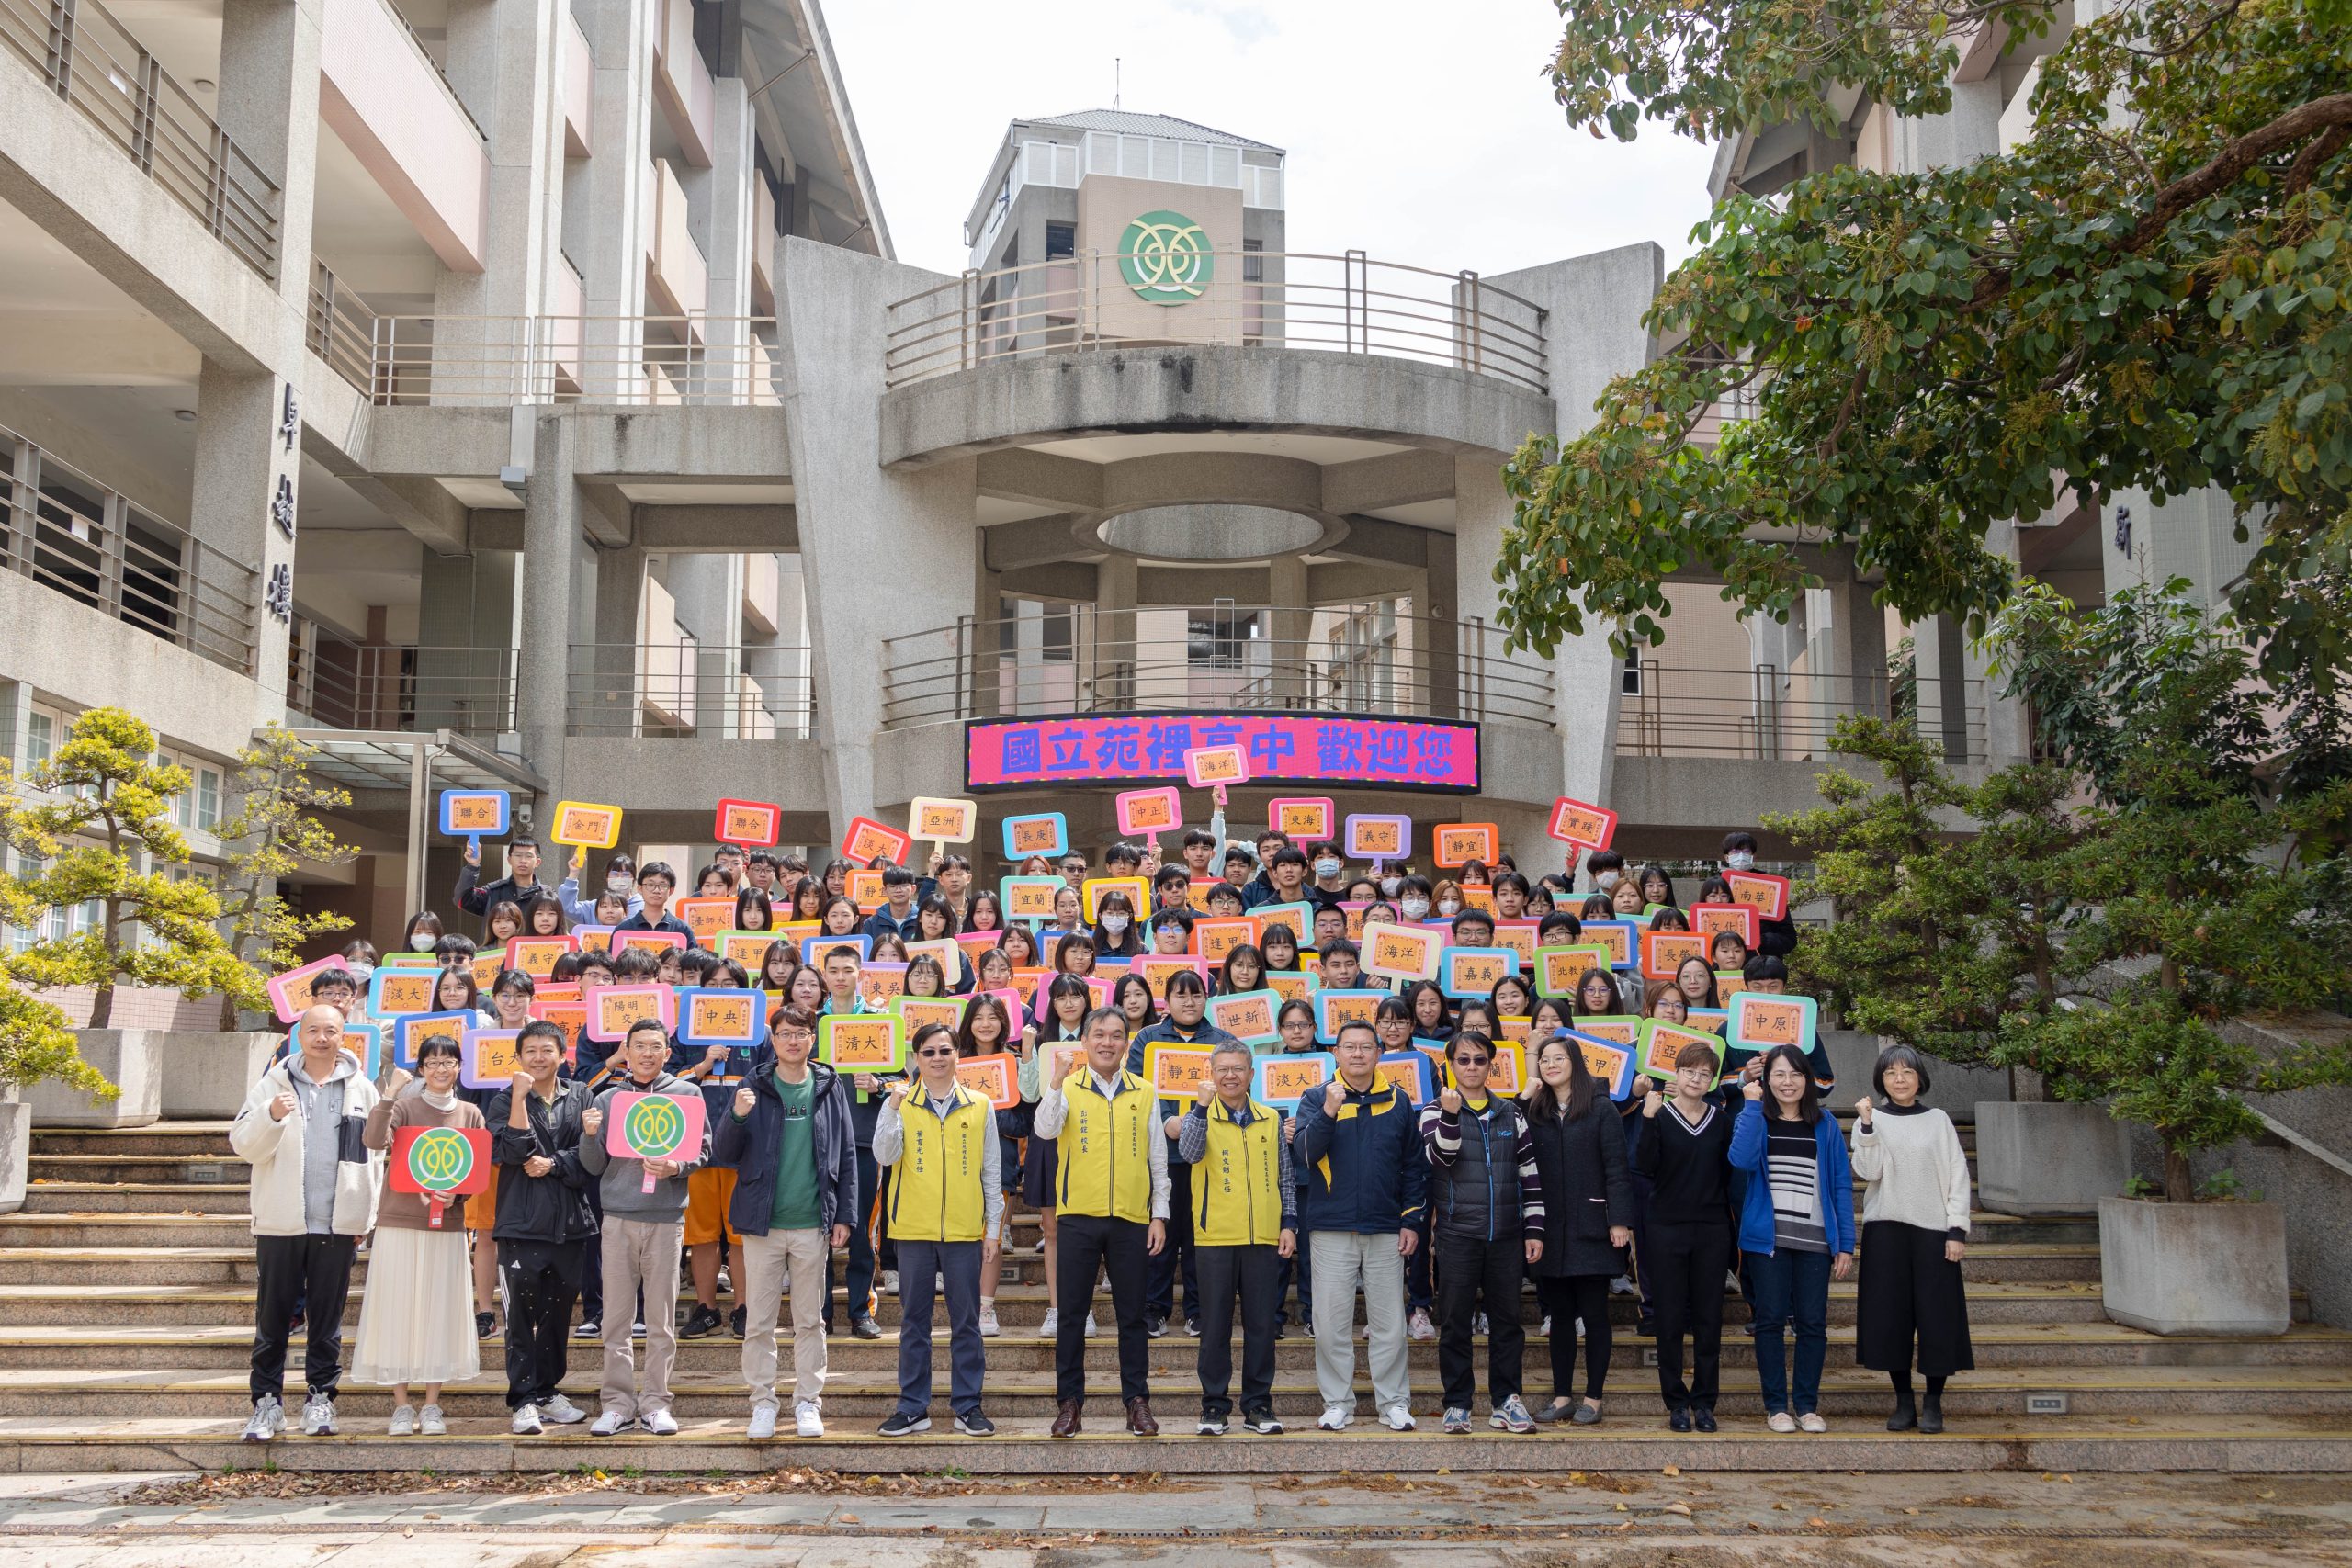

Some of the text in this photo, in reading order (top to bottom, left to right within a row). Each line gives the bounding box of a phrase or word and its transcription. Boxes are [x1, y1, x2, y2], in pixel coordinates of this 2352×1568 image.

[1317, 725, 1453, 775] 歡迎您
[1205, 760, 1229, 772] 海洋
[460, 807, 489, 819] 聯合
[1137, 806, 1161, 818] 中正
[572, 819, 600, 833] 金門
[735, 818, 760, 830] 聯合
[929, 816, 955, 828] 亞洲
[1292, 814, 1315, 827] 東海
[1567, 817, 1593, 834] 實踐
[1022, 829, 1047, 842] 長庚
[1363, 830, 1389, 843] 義守
[863, 838, 888, 855] 淡大
[1452, 840, 1477, 853] 靜宜
[1021, 894, 1045, 906] 宜蘭
[1740, 889, 1766, 903] 南華
[695, 916, 726, 927] 臺師大
[1710, 921, 1737, 932] 文化
[1210, 936, 1238, 951] 逢甲
[527, 953, 554, 965] 義守
[735, 948, 763, 960] 逢甲
[1385, 944, 1414, 961] 海洋
[1464, 966, 1493, 981] 嘉義
[1557, 964, 1587, 976] 北教大
[390, 988, 421, 1000] 淡大
[871, 981, 901, 996] 東吳
[614, 1000, 639, 1012] 陽明
[622, 1012, 644, 1024] 交大
[706, 1009, 738, 1025] 中央
[1227, 1010, 1259, 1027] 世新
[1337, 1009, 1366, 1022] 輔大
[1756, 1014, 1787, 1032] 中原
[845, 1035, 879, 1051] 清大
[492, 1051, 518, 1066] 台大
[1168, 1065, 1201, 1080] 靜宜
[1276, 1072, 1310, 1088] 淡大
